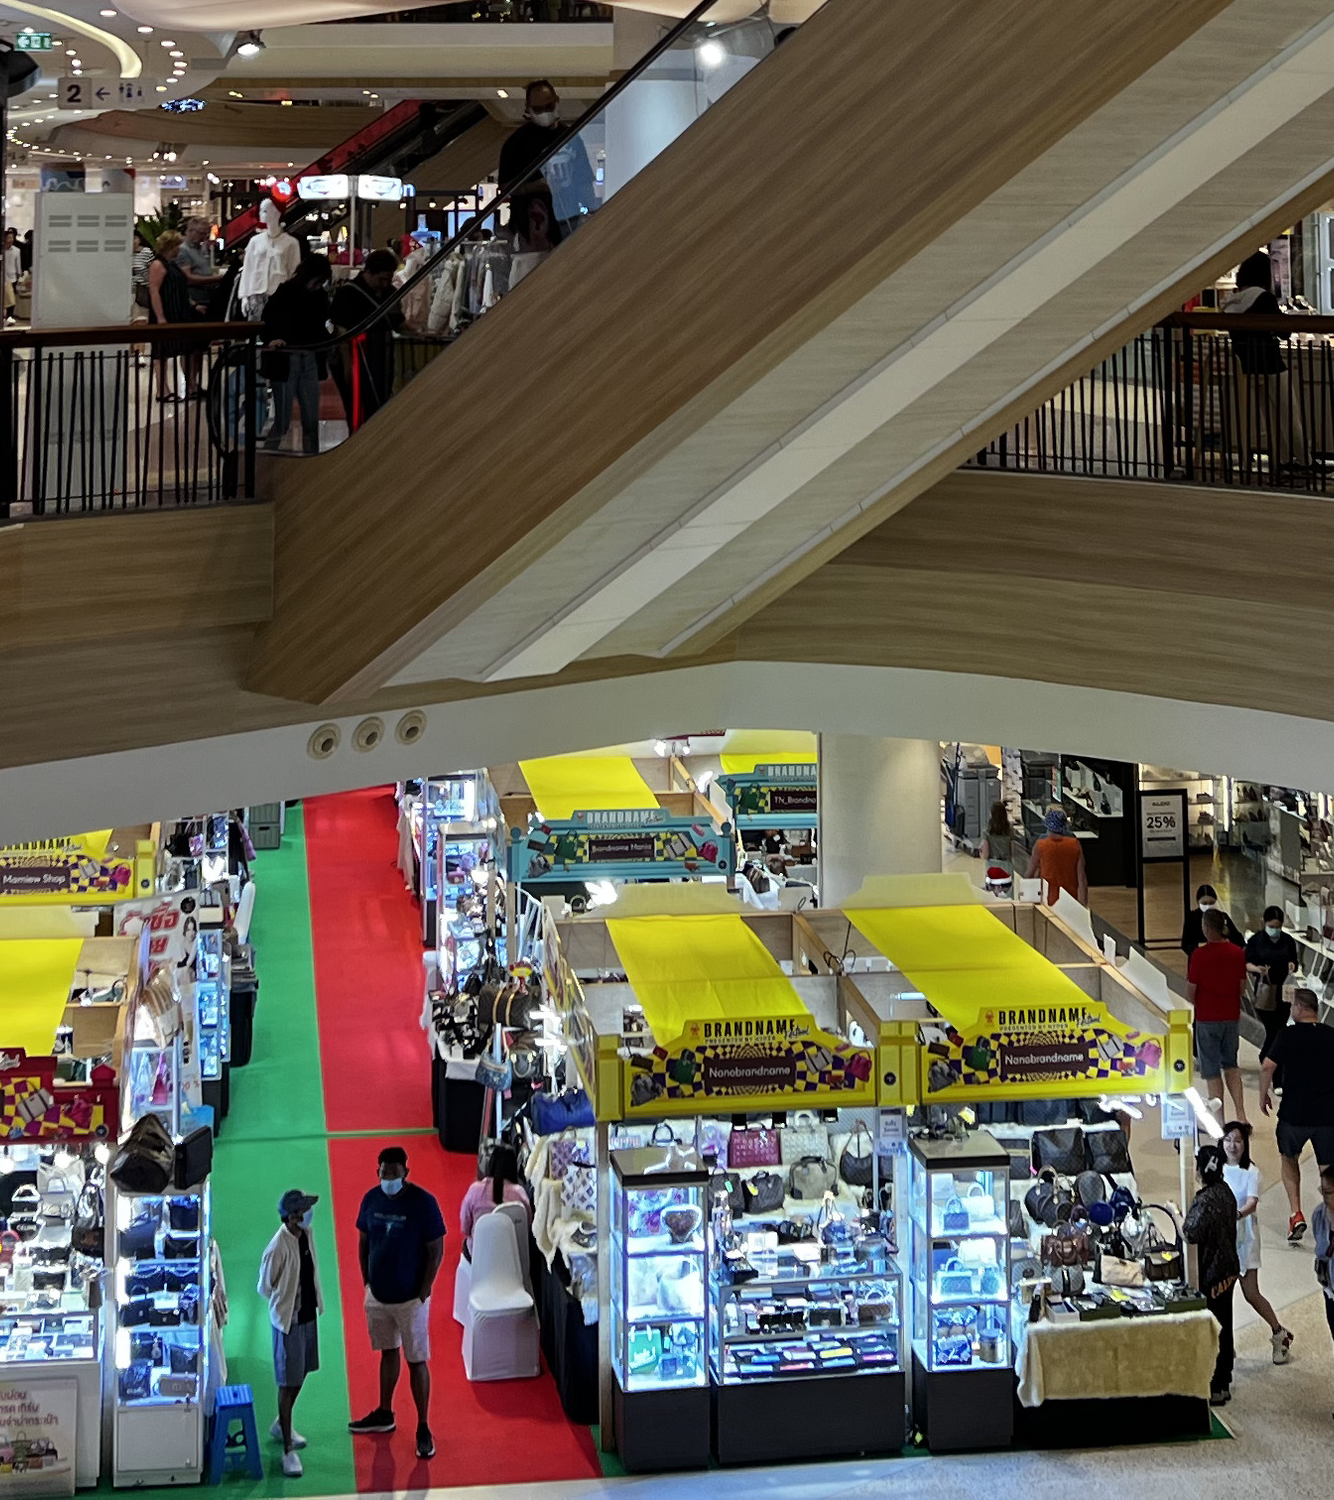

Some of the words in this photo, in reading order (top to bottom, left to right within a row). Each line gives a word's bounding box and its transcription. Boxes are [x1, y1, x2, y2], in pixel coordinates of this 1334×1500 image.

[67, 84, 82, 103] 2
[1147, 816, 1176, 829] 25%
[998, 1007, 1087, 1025] BRANDNAME
[704, 1019, 795, 1038] BRANDNAME
